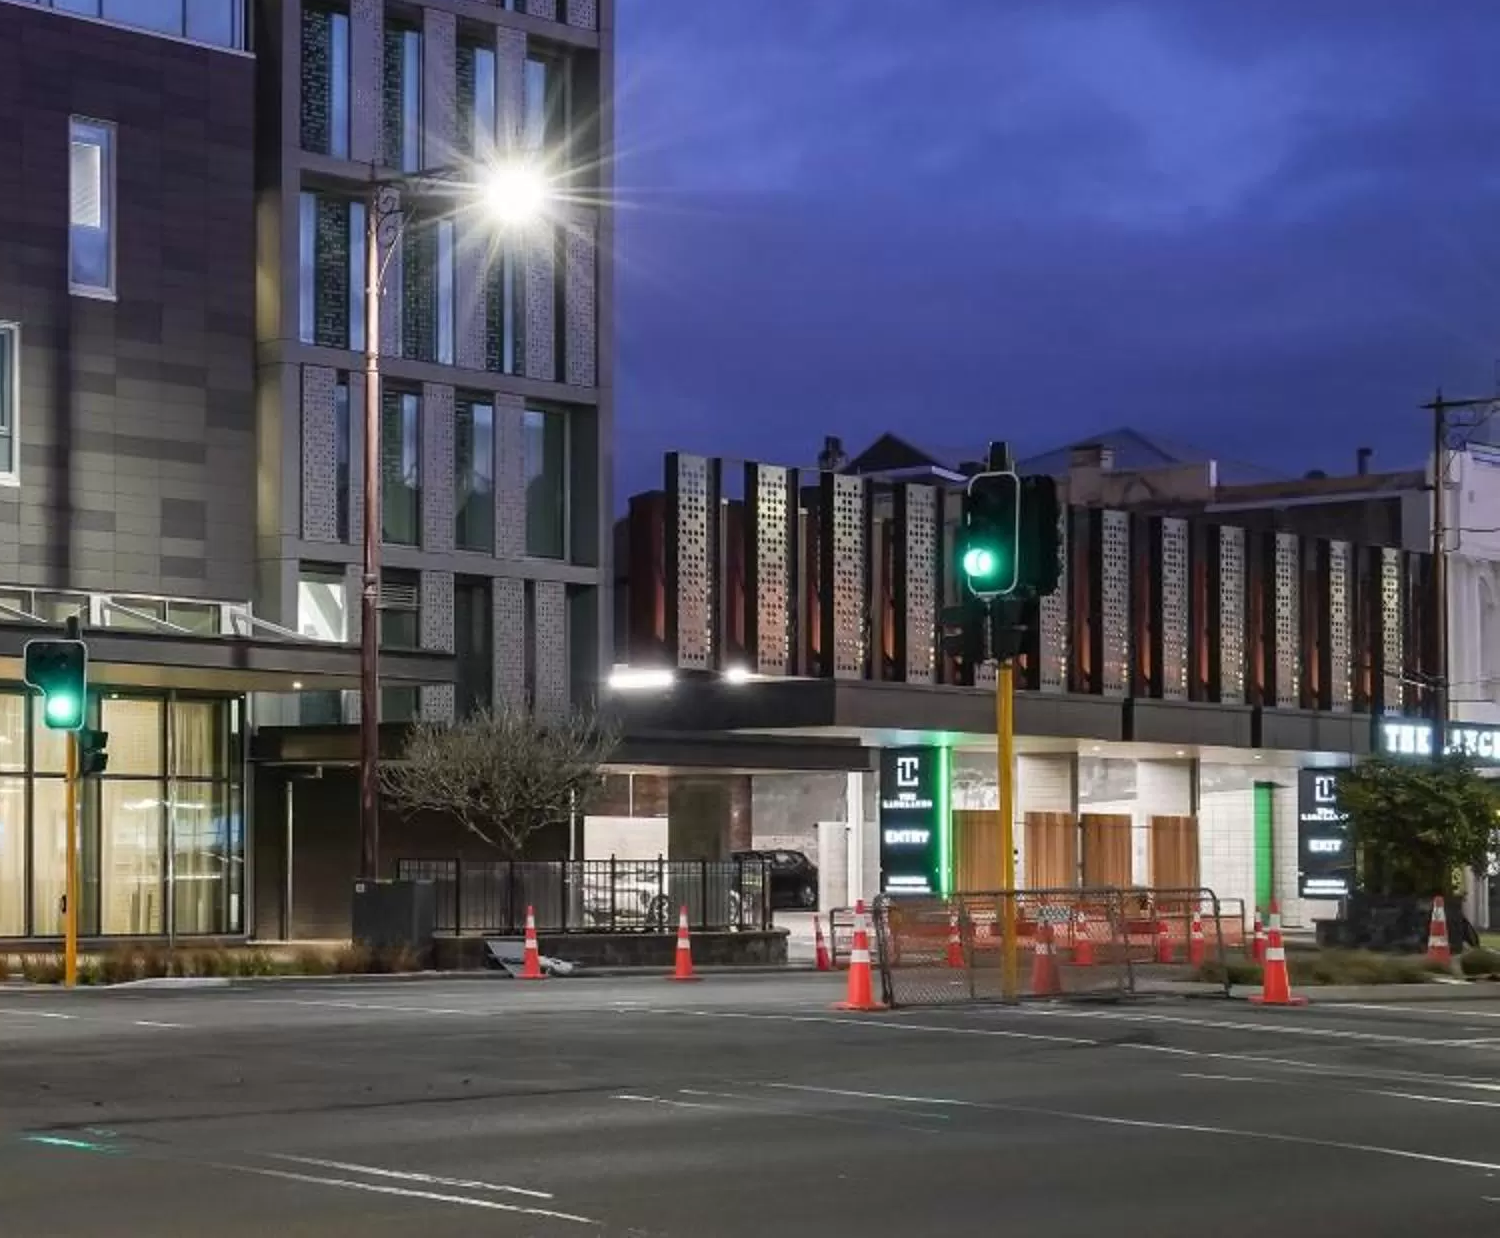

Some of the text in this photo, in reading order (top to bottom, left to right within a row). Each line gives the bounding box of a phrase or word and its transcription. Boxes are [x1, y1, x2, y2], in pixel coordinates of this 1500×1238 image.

[1384, 724, 1432, 754] THE
[884, 829, 930, 844] ENTRY
[1308, 839, 1342, 853] EXIT
